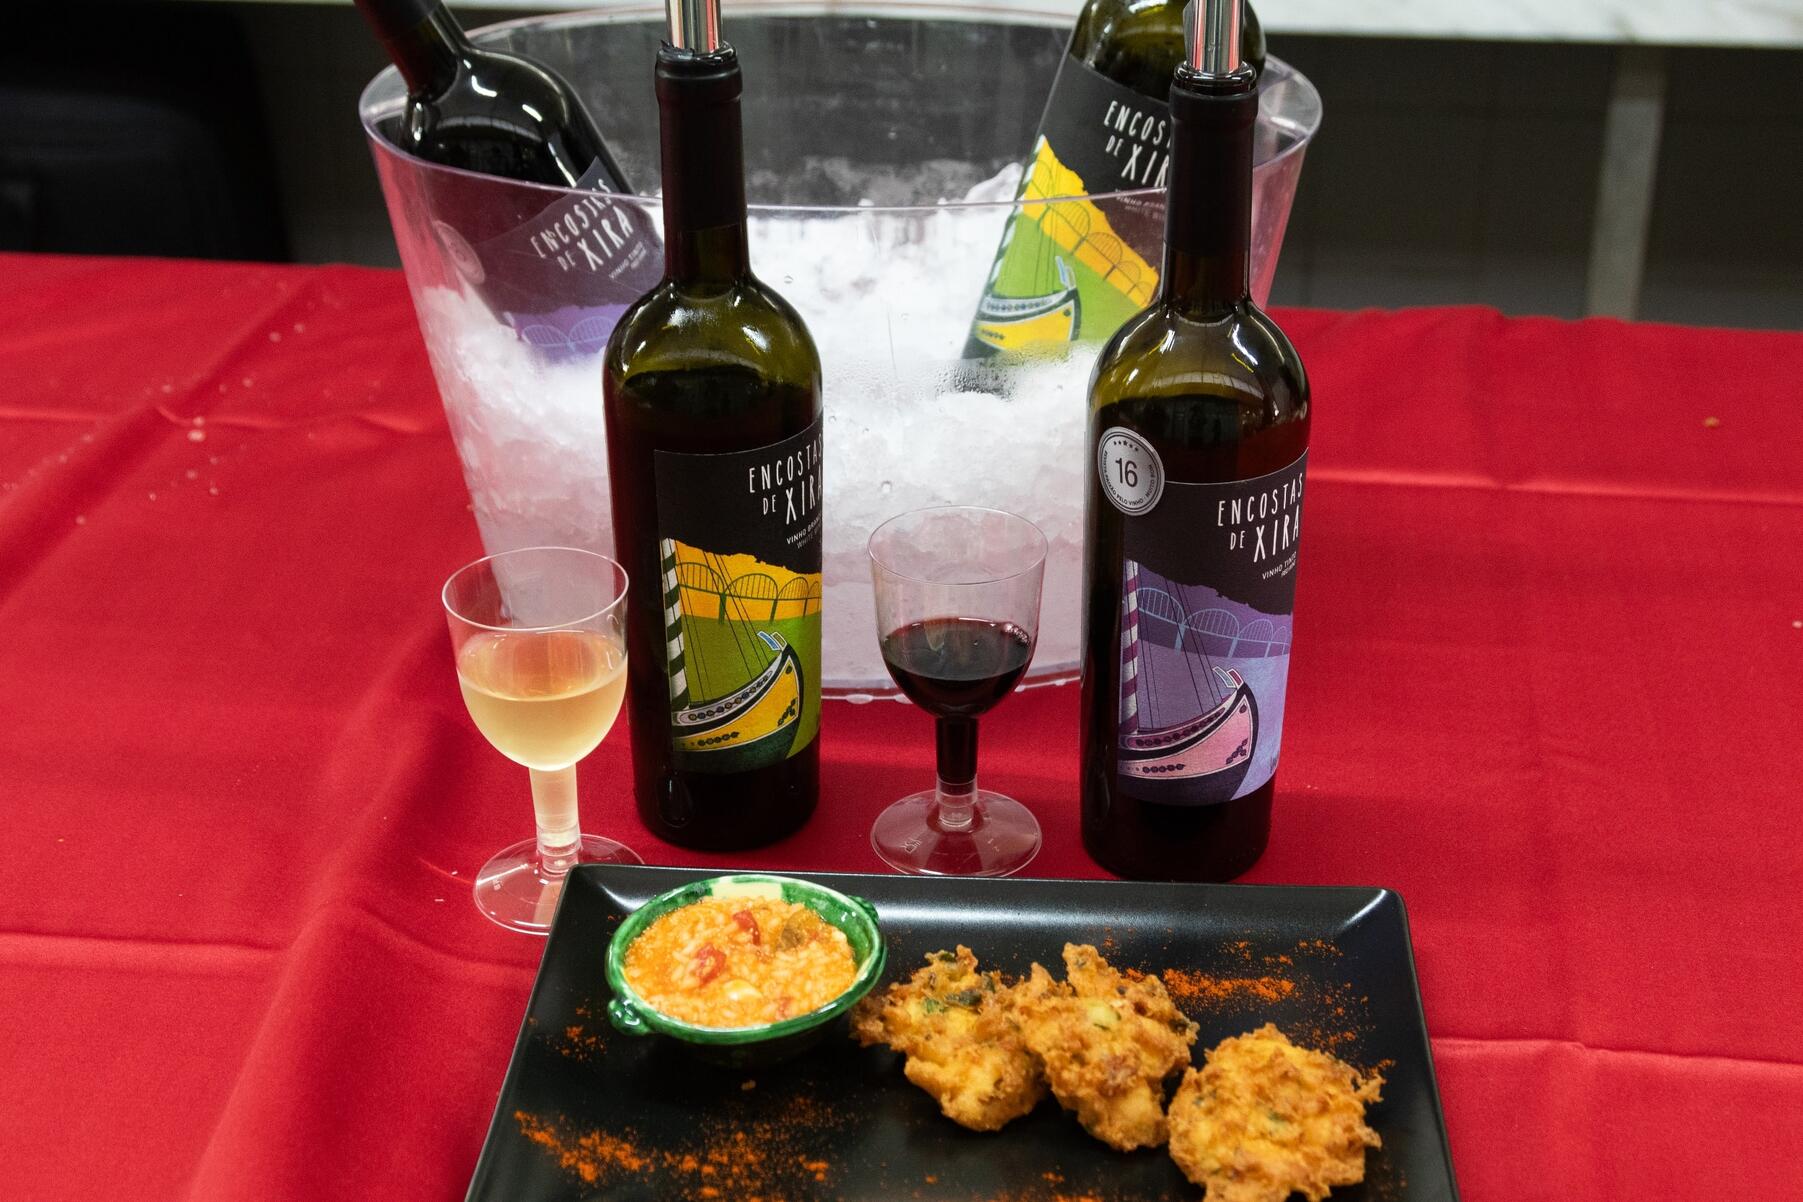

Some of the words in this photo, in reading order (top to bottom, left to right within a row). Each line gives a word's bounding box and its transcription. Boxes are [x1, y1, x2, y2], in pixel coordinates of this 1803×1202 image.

[1104, 100, 1170, 149] ENCOS
[1105, 135, 1123, 156] DE
[1121, 144, 1169, 193] XIR
[530, 179, 612, 259] ENCOSTAS
[557, 250, 576, 271] DE
[577, 205, 634, 271] XIRA
[1115, 457, 1138, 487] 16
[763, 494, 776, 515] DE
[1218, 473, 1303, 527] ENCOSTAS
[786, 528, 807, 544] VINHO
[1230, 530, 1246, 551] DE
[1253, 505, 1300, 563] XIRA
[1262, 564, 1283, 580] VINHO
